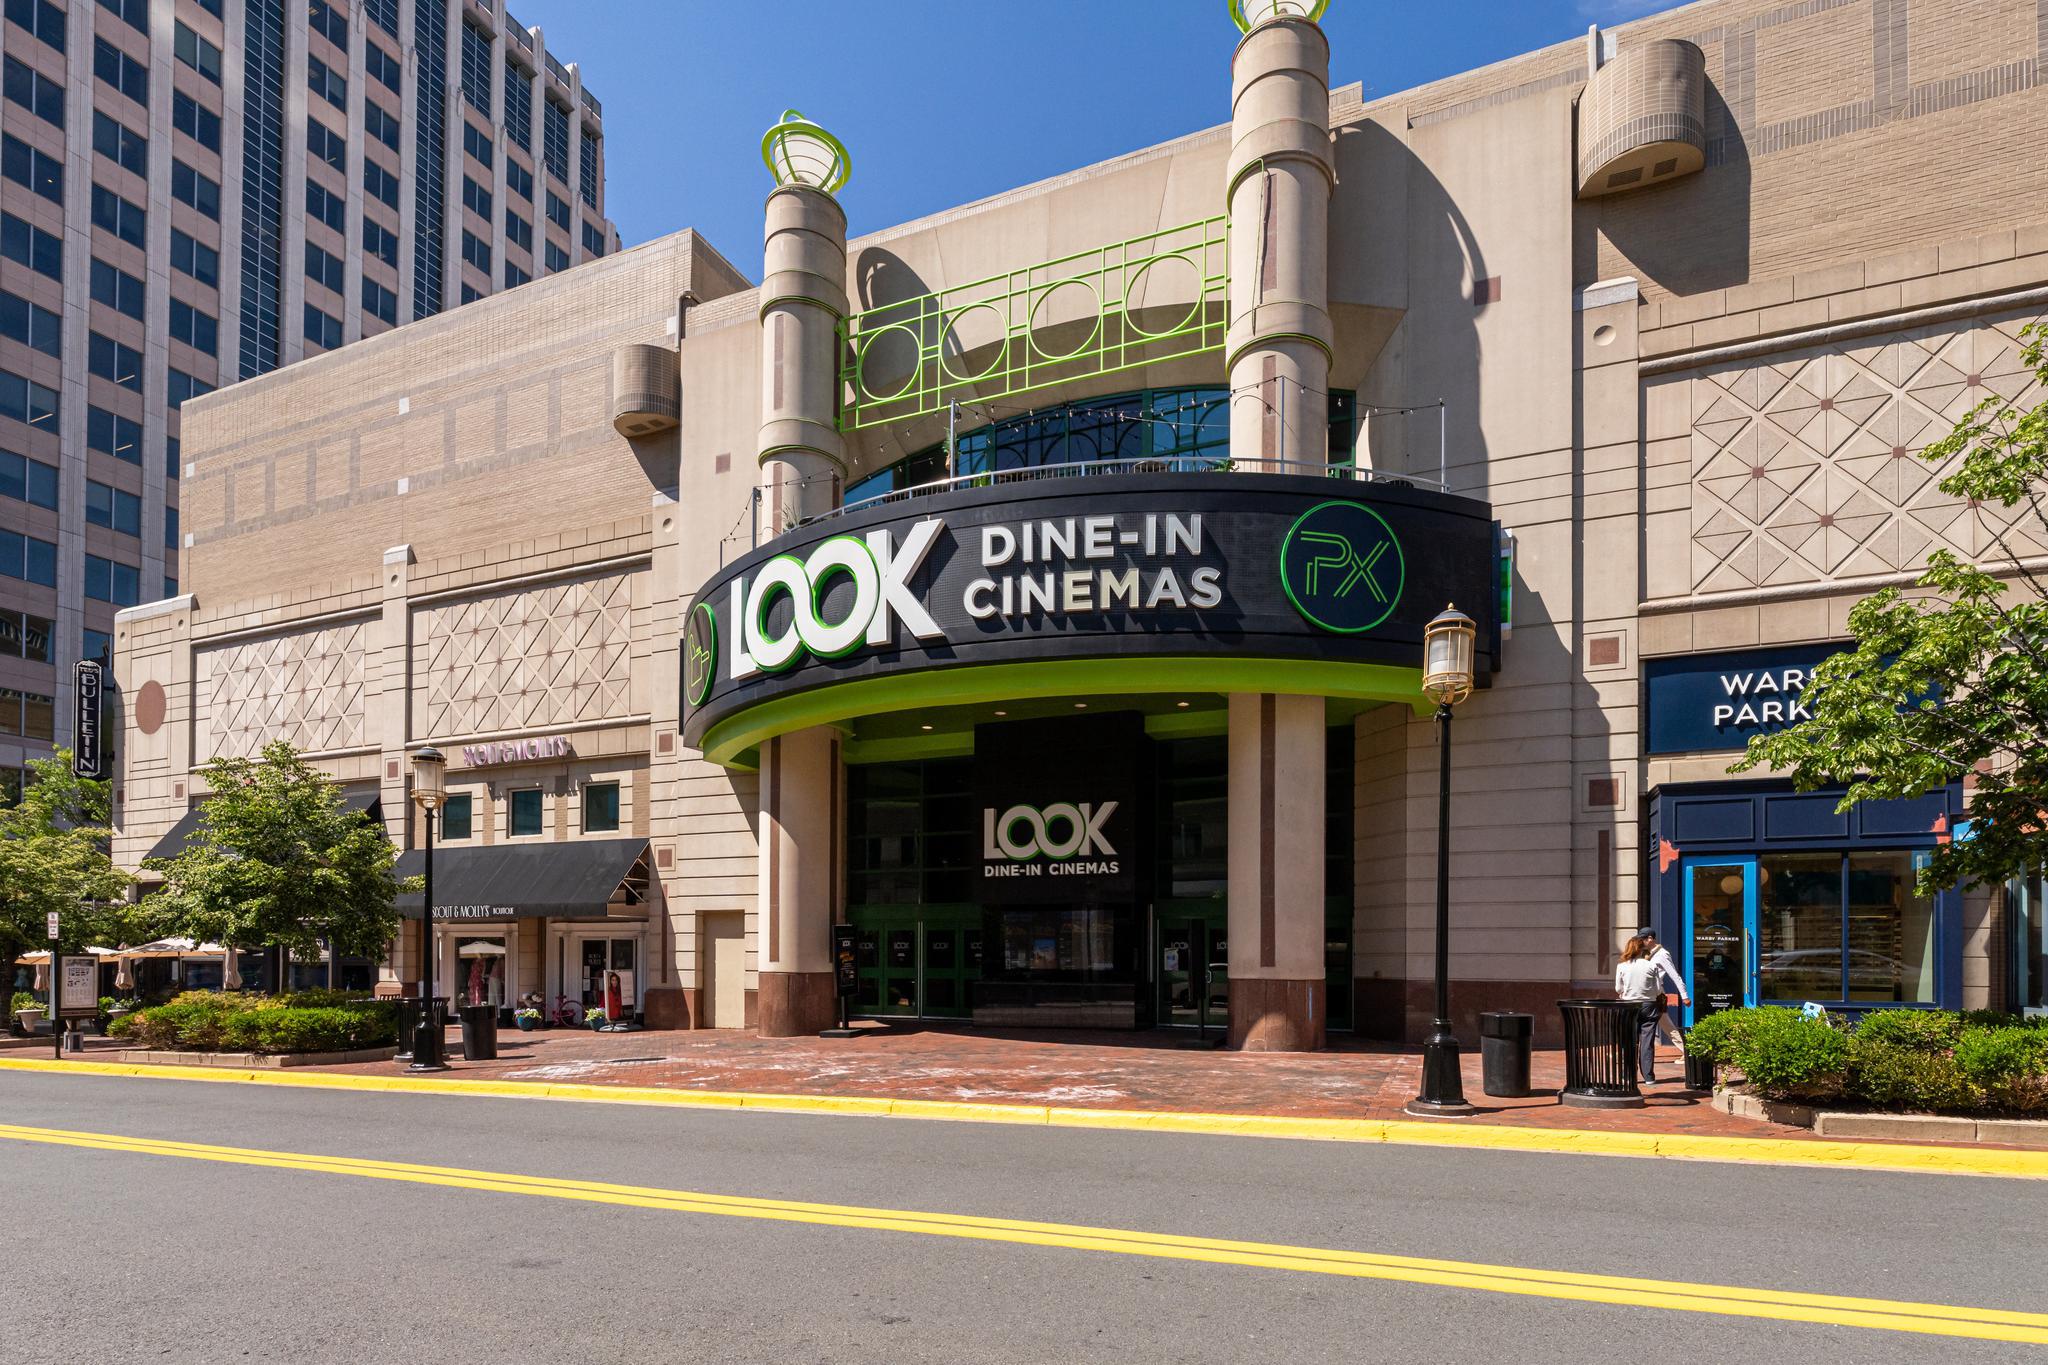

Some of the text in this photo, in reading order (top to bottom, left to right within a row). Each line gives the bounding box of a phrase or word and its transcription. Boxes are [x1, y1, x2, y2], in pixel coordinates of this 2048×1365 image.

[981, 512, 1203, 567] DINE-IN
[730, 518, 947, 681] LOOK
[963, 566, 1222, 619] CINEMAS
[1720, 668, 1817, 696] WAR
[80, 673, 97, 770] BULLETIN
[1713, 700, 1813, 726] PARK
[983, 801, 1119, 861] LOOK
[984, 861, 1120, 877] DINE-IN CINEMAS
[460, 904, 490, 918] MOLLY'S
